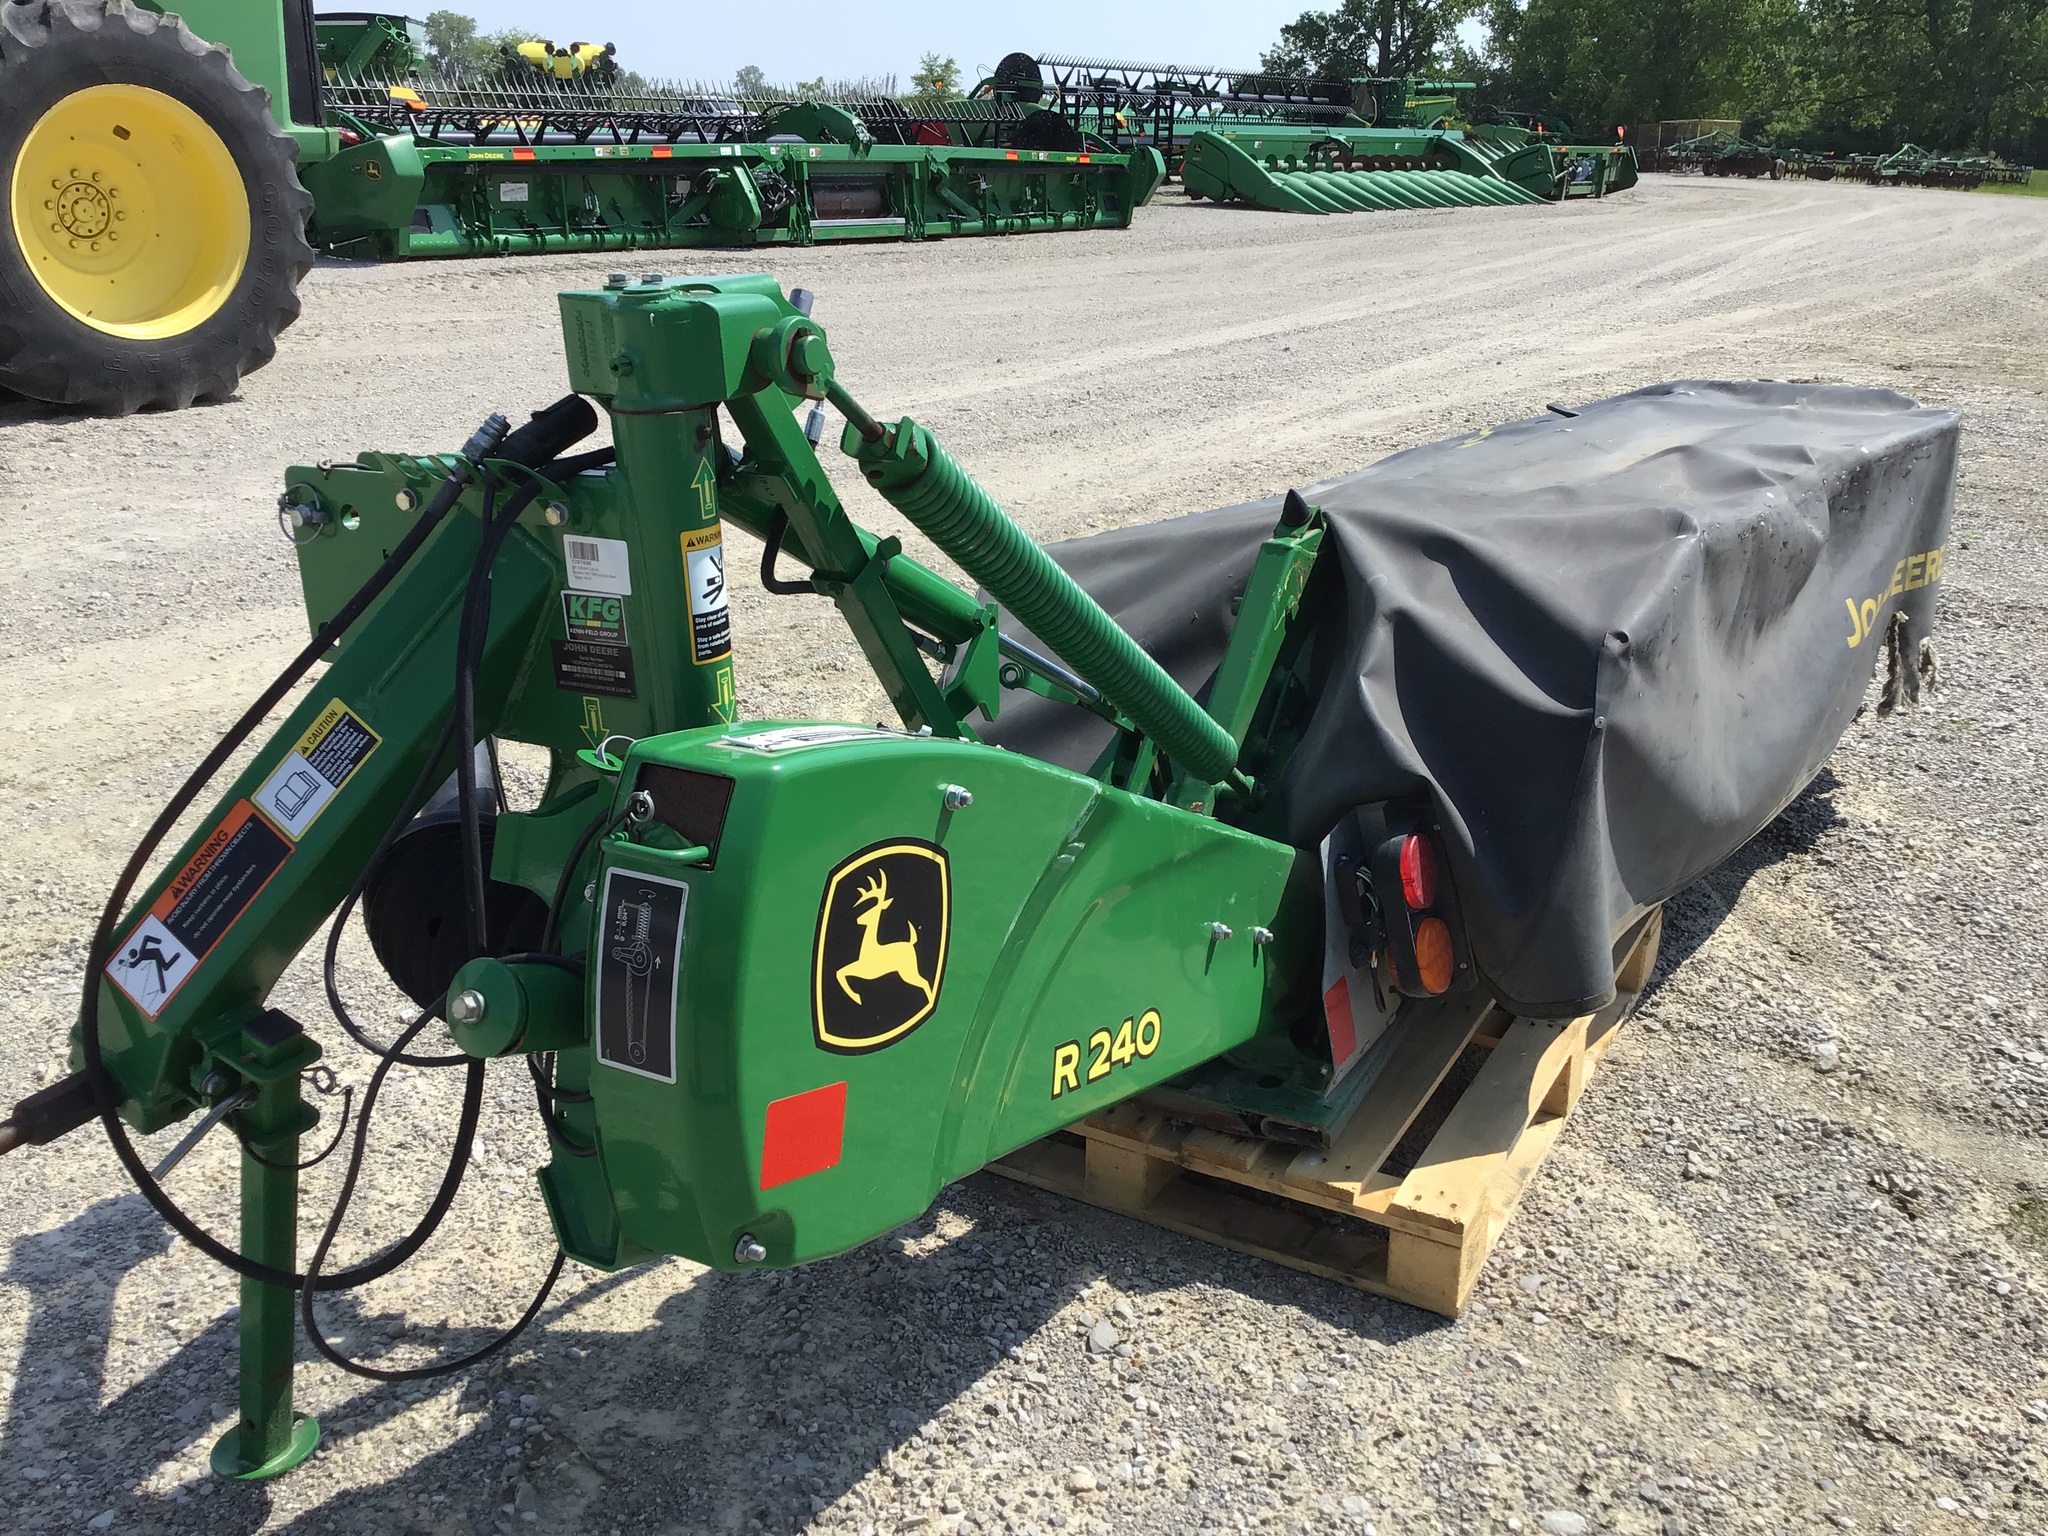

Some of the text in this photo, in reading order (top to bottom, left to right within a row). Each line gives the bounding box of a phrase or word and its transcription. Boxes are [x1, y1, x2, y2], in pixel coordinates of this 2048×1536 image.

[696, 532, 721, 545] WARN
[570, 596, 620, 621] KFG
[563, 643, 619, 656] JOHN DEERE
[307, 709, 337, 744] CAUTION
[308, 714, 349, 762] Read operator manual
[167, 822, 252, 924] AVOID INJURY FROM THROWN OBJECTS
[178, 830, 228, 887] WARNING
[182, 914, 195, 928] Keep
[617, 906, 622, 919] mm
[1051, 1007, 1162, 1100] R 240
